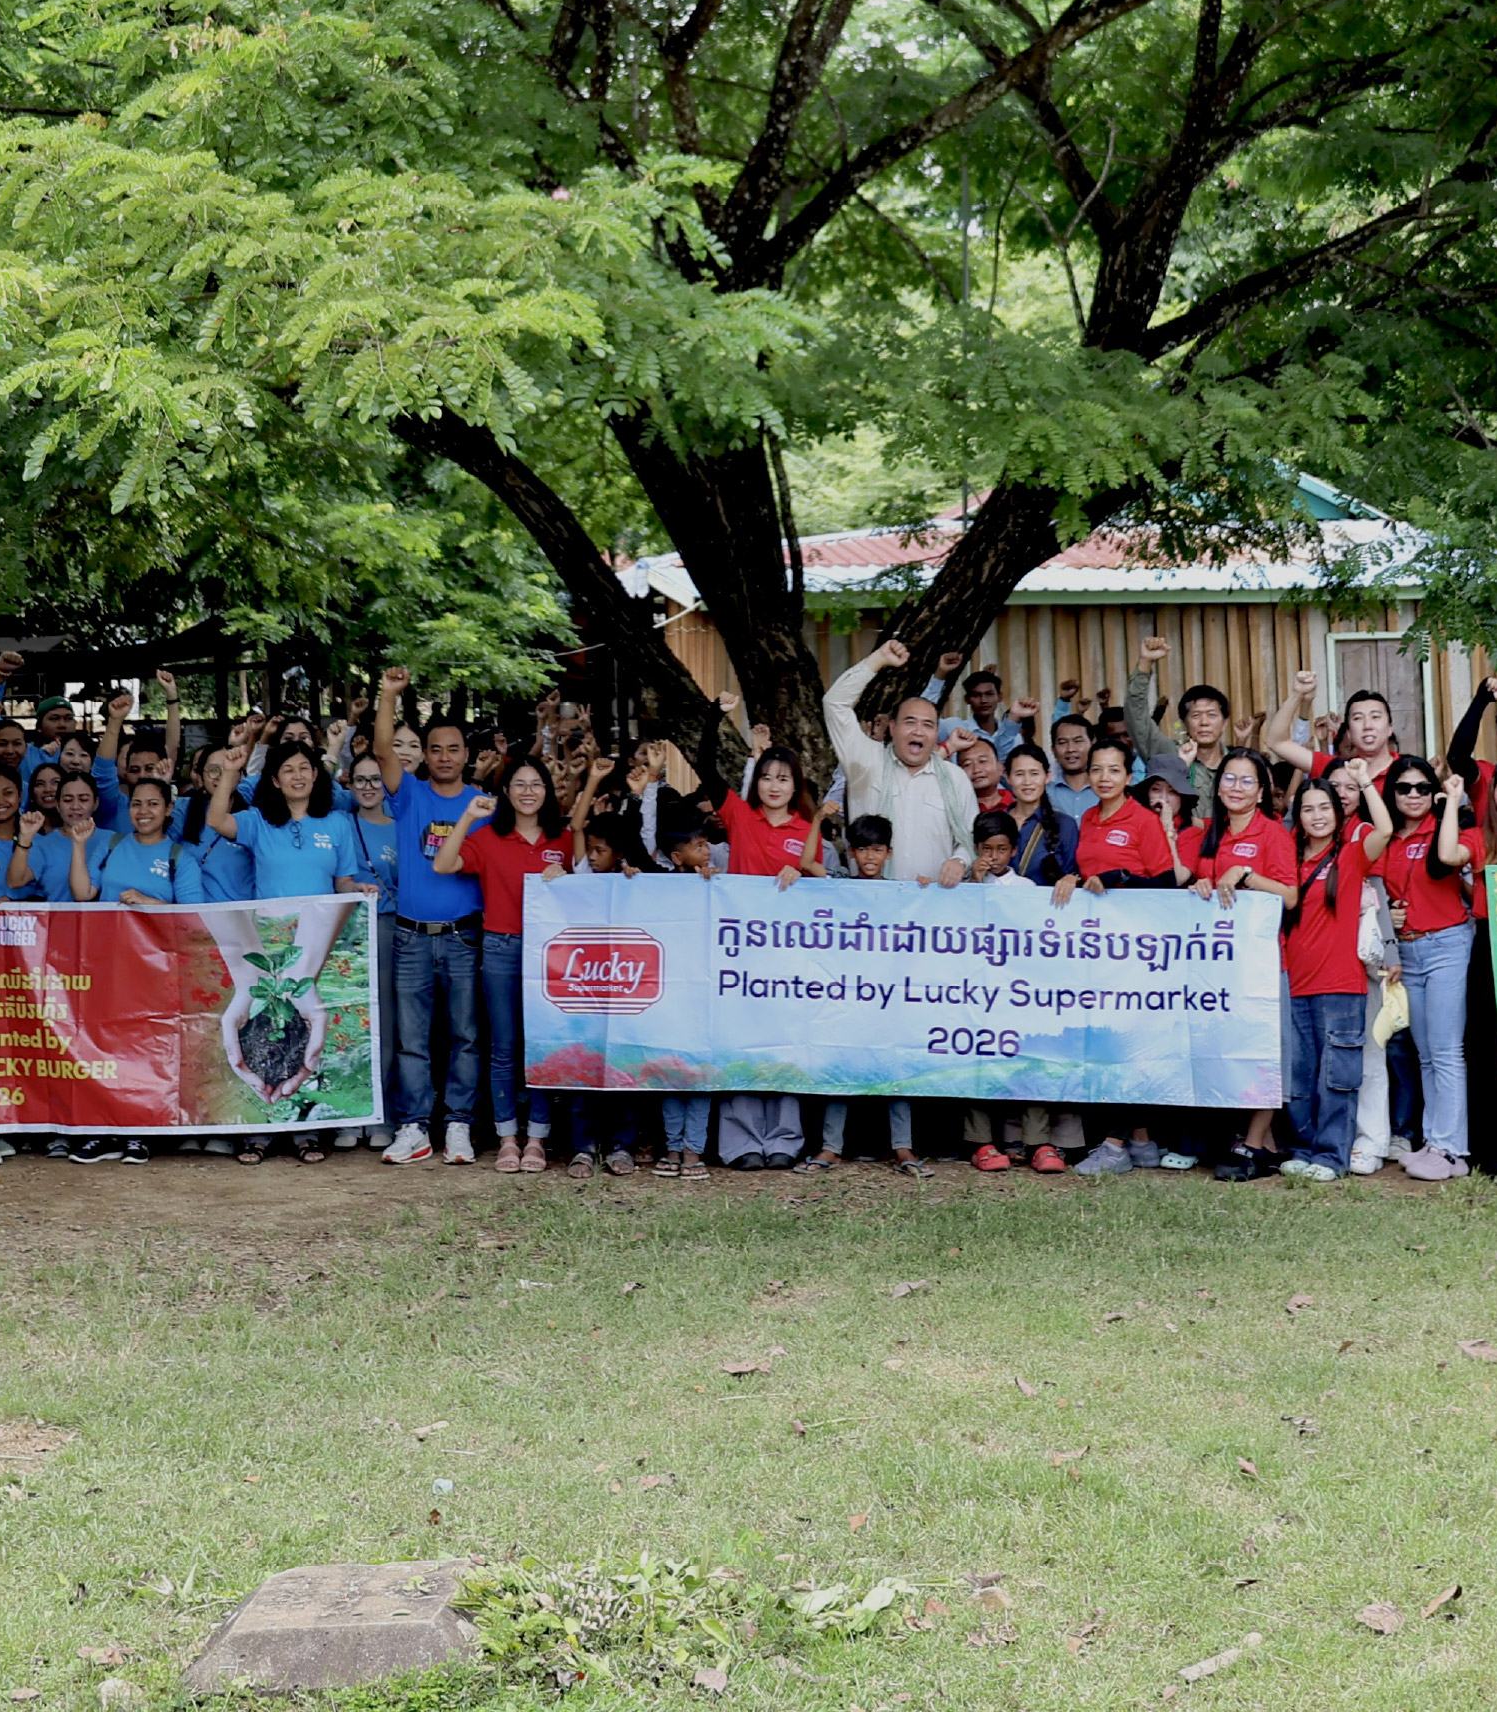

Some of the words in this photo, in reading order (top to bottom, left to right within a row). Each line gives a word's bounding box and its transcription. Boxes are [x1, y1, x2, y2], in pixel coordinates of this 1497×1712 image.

[561, 947, 646, 994] Lucky
[718, 969, 846, 1000] Planted
[856, 974, 896, 1010] by
[904, 976, 1000, 1013] Lucky
[1009, 979, 1231, 1015] Supermarket
[45, 1028, 72, 1055] by
[927, 1026, 1021, 1058] 2026
[37, 1060, 118, 1080] BURGER
